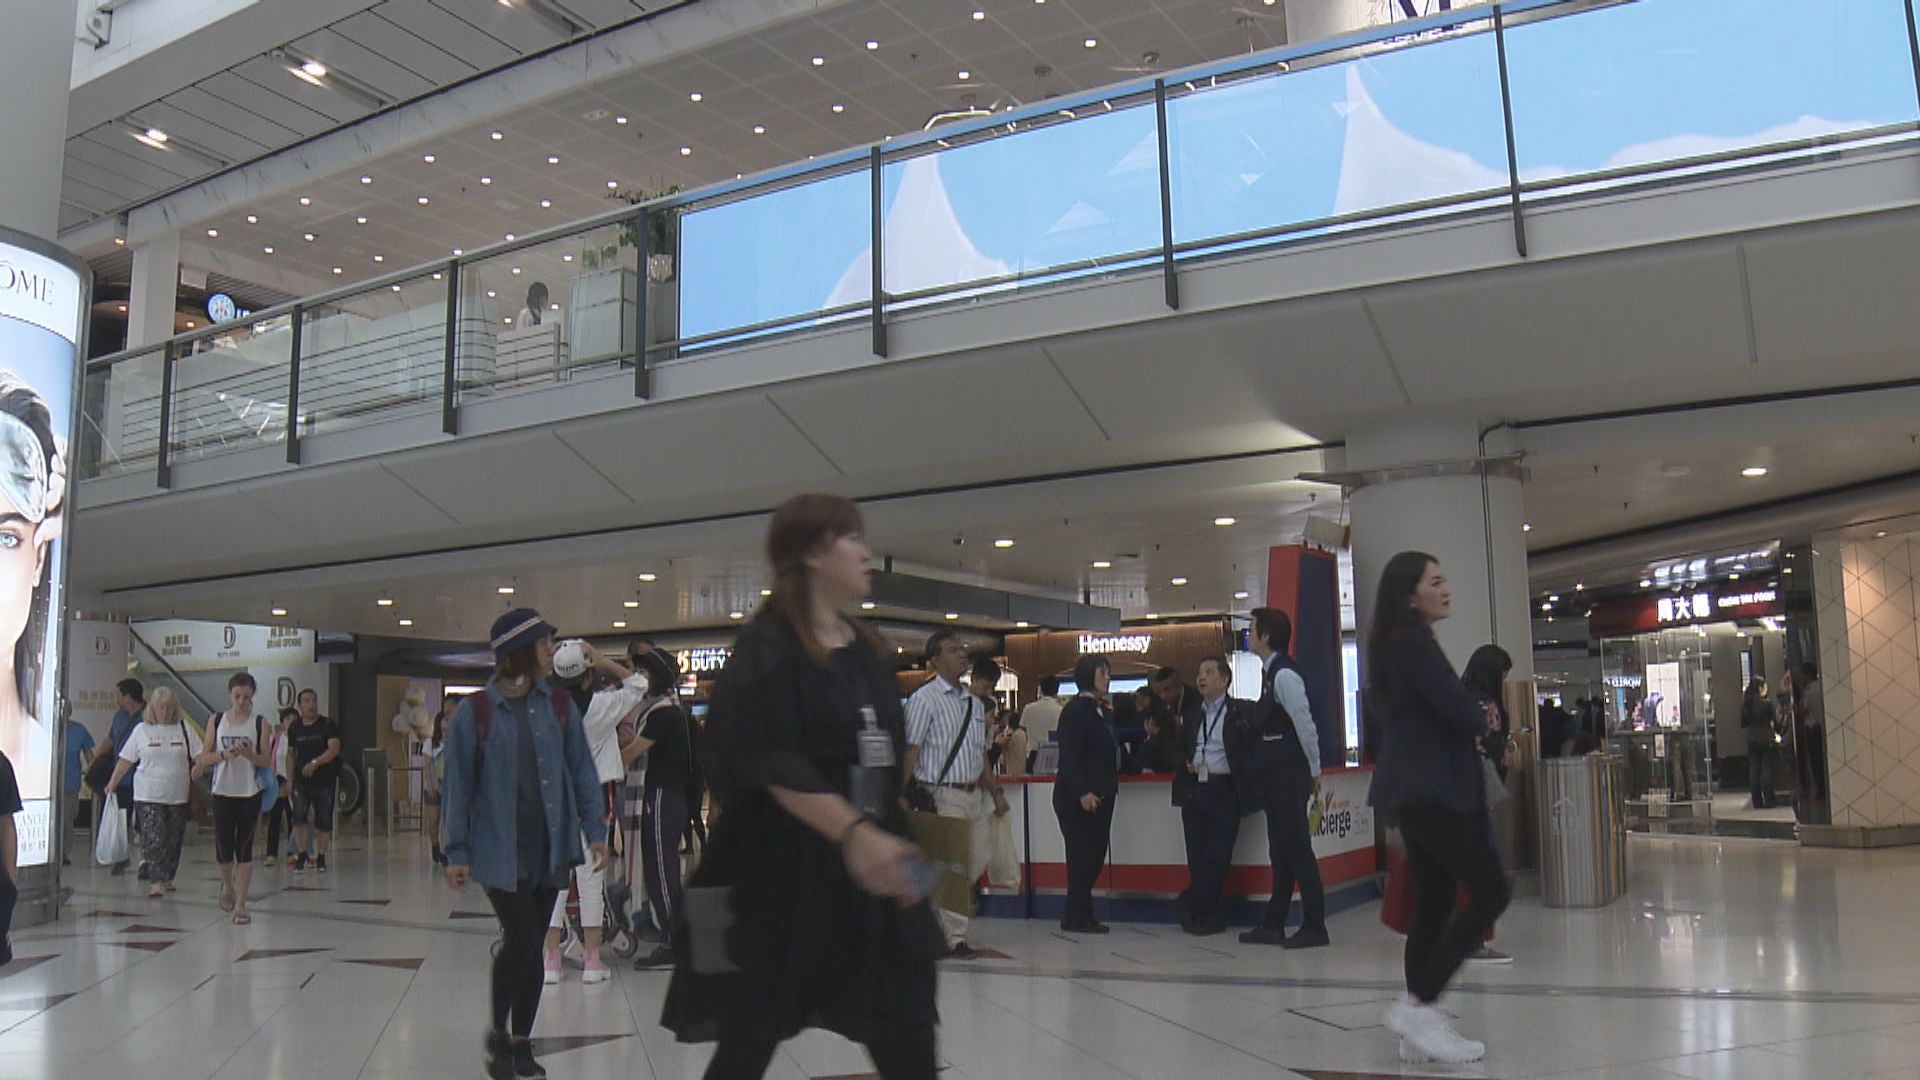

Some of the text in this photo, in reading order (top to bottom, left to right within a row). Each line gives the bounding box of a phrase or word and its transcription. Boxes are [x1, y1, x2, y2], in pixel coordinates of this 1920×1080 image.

[1079, 633, 1152, 654] Hennessy
[691, 655, 726, 671] DUTY
[1315, 810, 1351, 838] cierge
